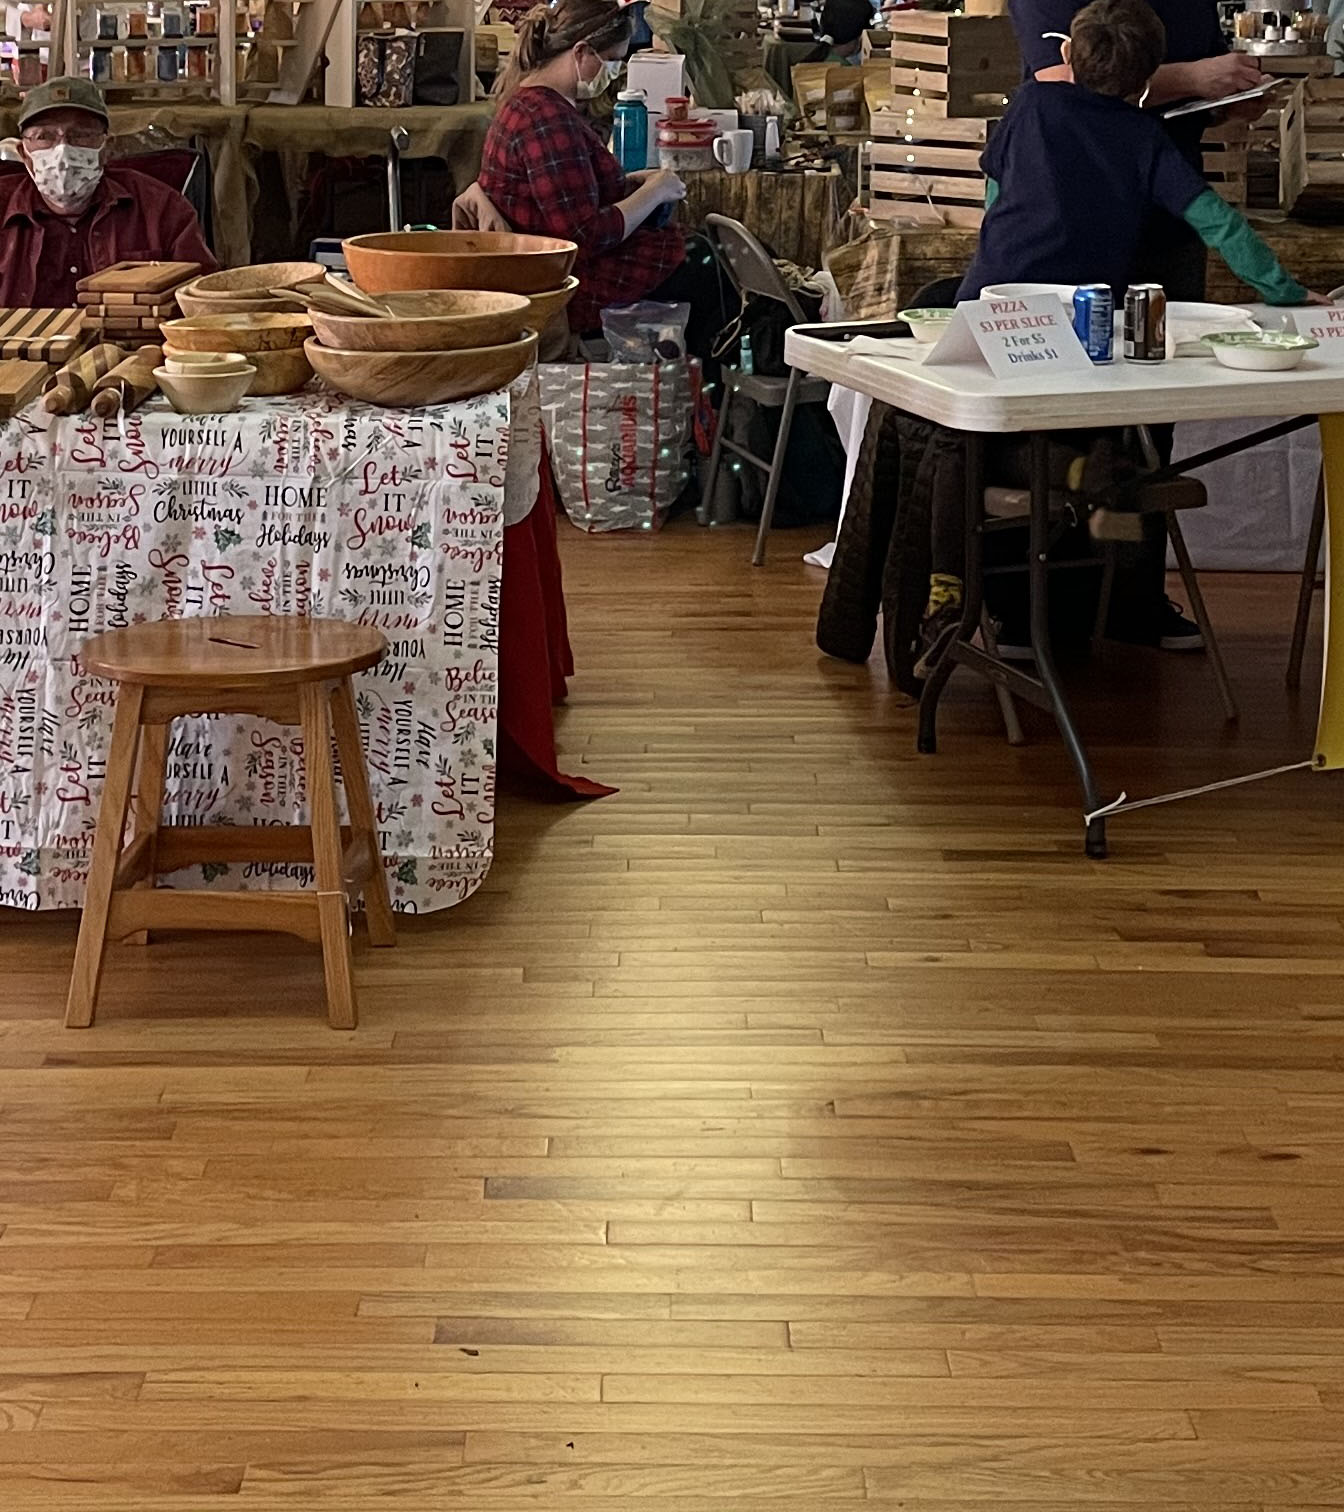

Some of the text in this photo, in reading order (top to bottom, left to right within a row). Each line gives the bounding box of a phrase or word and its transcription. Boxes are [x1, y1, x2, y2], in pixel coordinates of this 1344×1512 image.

[990, 301, 1027, 314] PIZZA
[980, 315, 1056, 333] $3 PER SLICE
[1311, 328, 1324, 338] $3
[1002, 333, 1045, 347] 2 For $5
[1008, 349, 1058, 363] Drinks $1
[475, 435, 493, 457] IT
[8, 480, 31, 498] IT
[182, 481, 218, 496] LITTLE
[359, 462, 403, 495] Let
[69, 484, 145, 516] Season
[265, 485, 327, 508] HOME
[384, 493, 406, 512] IT
[154, 497, 244, 523] Christmas
[256, 524, 331, 553] Holidays
[347, 509, 415, 550] Snow
[66, 525, 140, 558] Believe
[344, 566, 430, 591] Christmas
[69, 565, 91, 633] HOME
[444, 579, 466, 647] HOME
